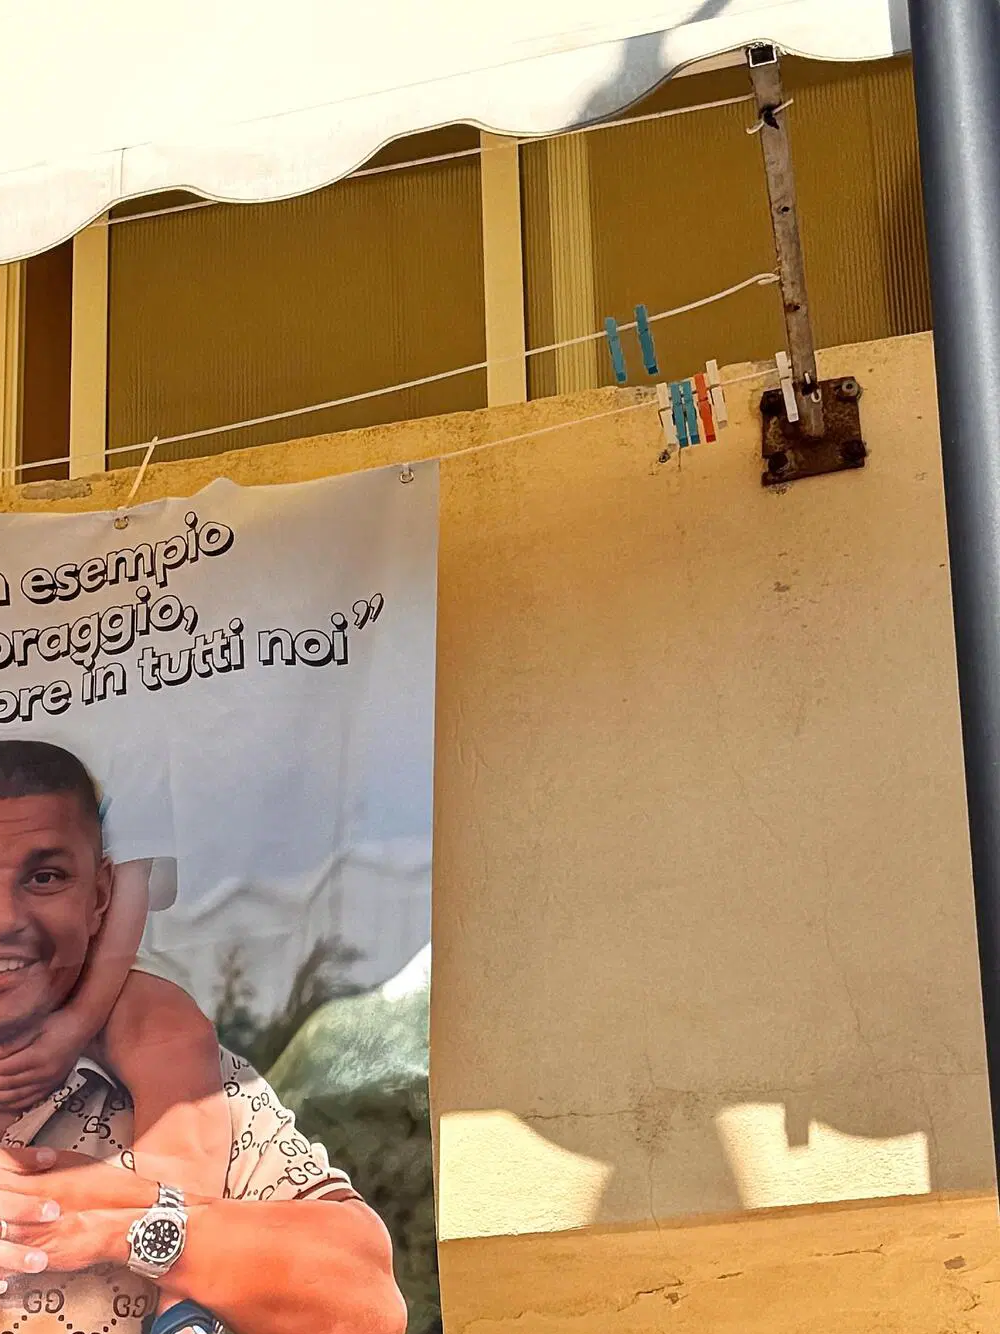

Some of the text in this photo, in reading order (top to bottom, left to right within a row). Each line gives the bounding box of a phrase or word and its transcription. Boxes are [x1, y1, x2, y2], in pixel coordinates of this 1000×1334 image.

[21, 511, 235, 605] esempio
[82, 655, 126, 705] in
[138, 617, 244, 691] tutti
